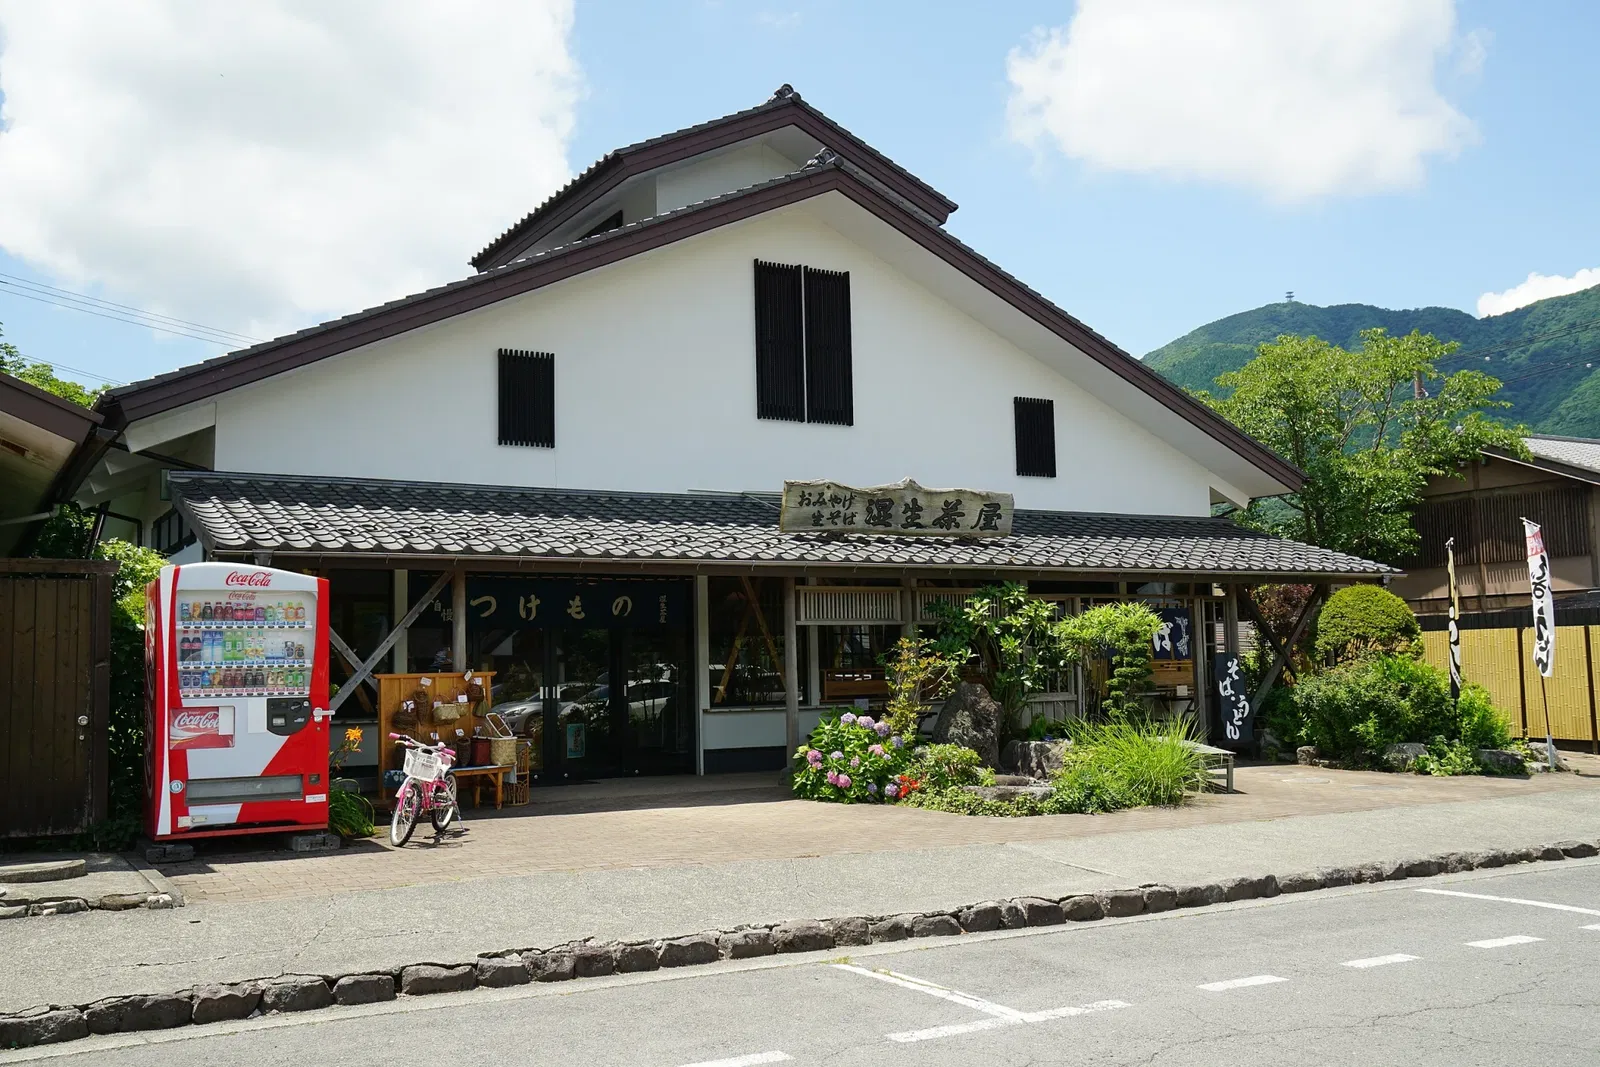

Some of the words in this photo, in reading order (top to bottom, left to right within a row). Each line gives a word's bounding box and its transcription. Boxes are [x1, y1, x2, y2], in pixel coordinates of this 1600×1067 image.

[798, 490, 857, 511] おみやげ
[811, 511, 858, 527] 生そば
[865, 498, 1003, 531] 湿生茶屋
[225, 570, 274, 587] Coca-Cola
[469, 593, 633, 621] つけもの
[173, 711, 219, 730] Coca-Col
